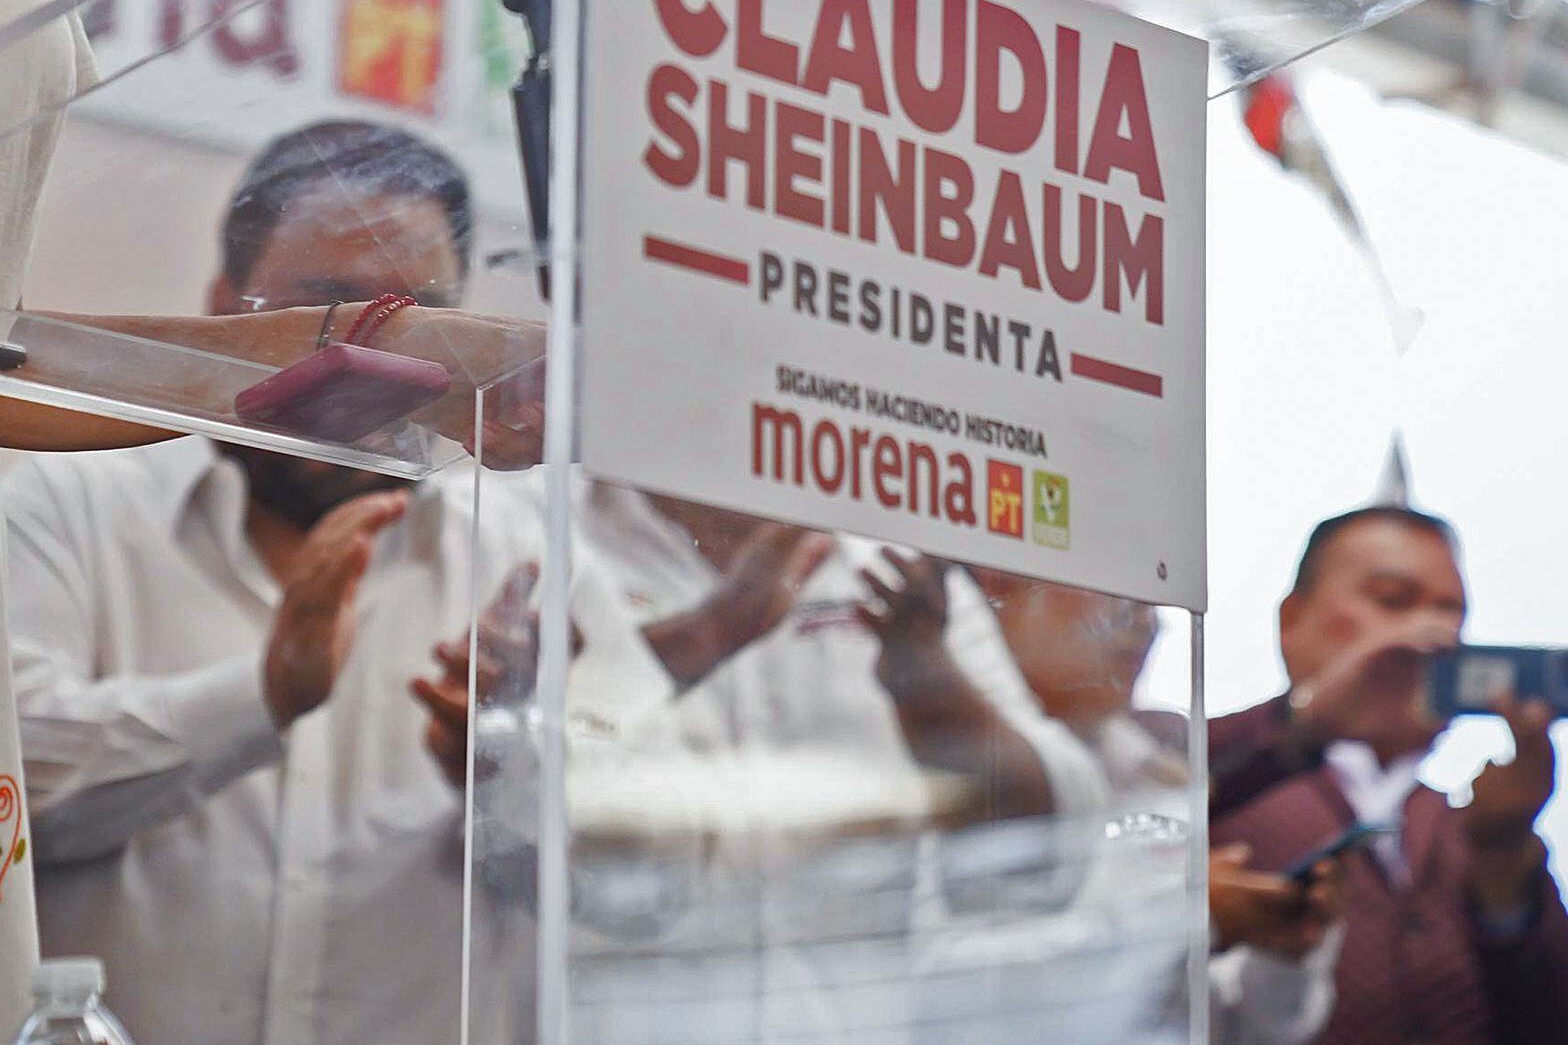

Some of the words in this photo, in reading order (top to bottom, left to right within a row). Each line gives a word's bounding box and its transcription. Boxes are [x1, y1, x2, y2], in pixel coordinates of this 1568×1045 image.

[642, 62, 1164, 325] SHEINBAUM
[759, 252, 1062, 382] PRESIDENTA
[752, 401, 976, 527] morena
[776, 365, 861, 412] SIGAMOS
[865, 388, 960, 436] HACIENDO
[965, 414, 1047, 458] HISTORIA
[989, 491, 1021, 534] PT
